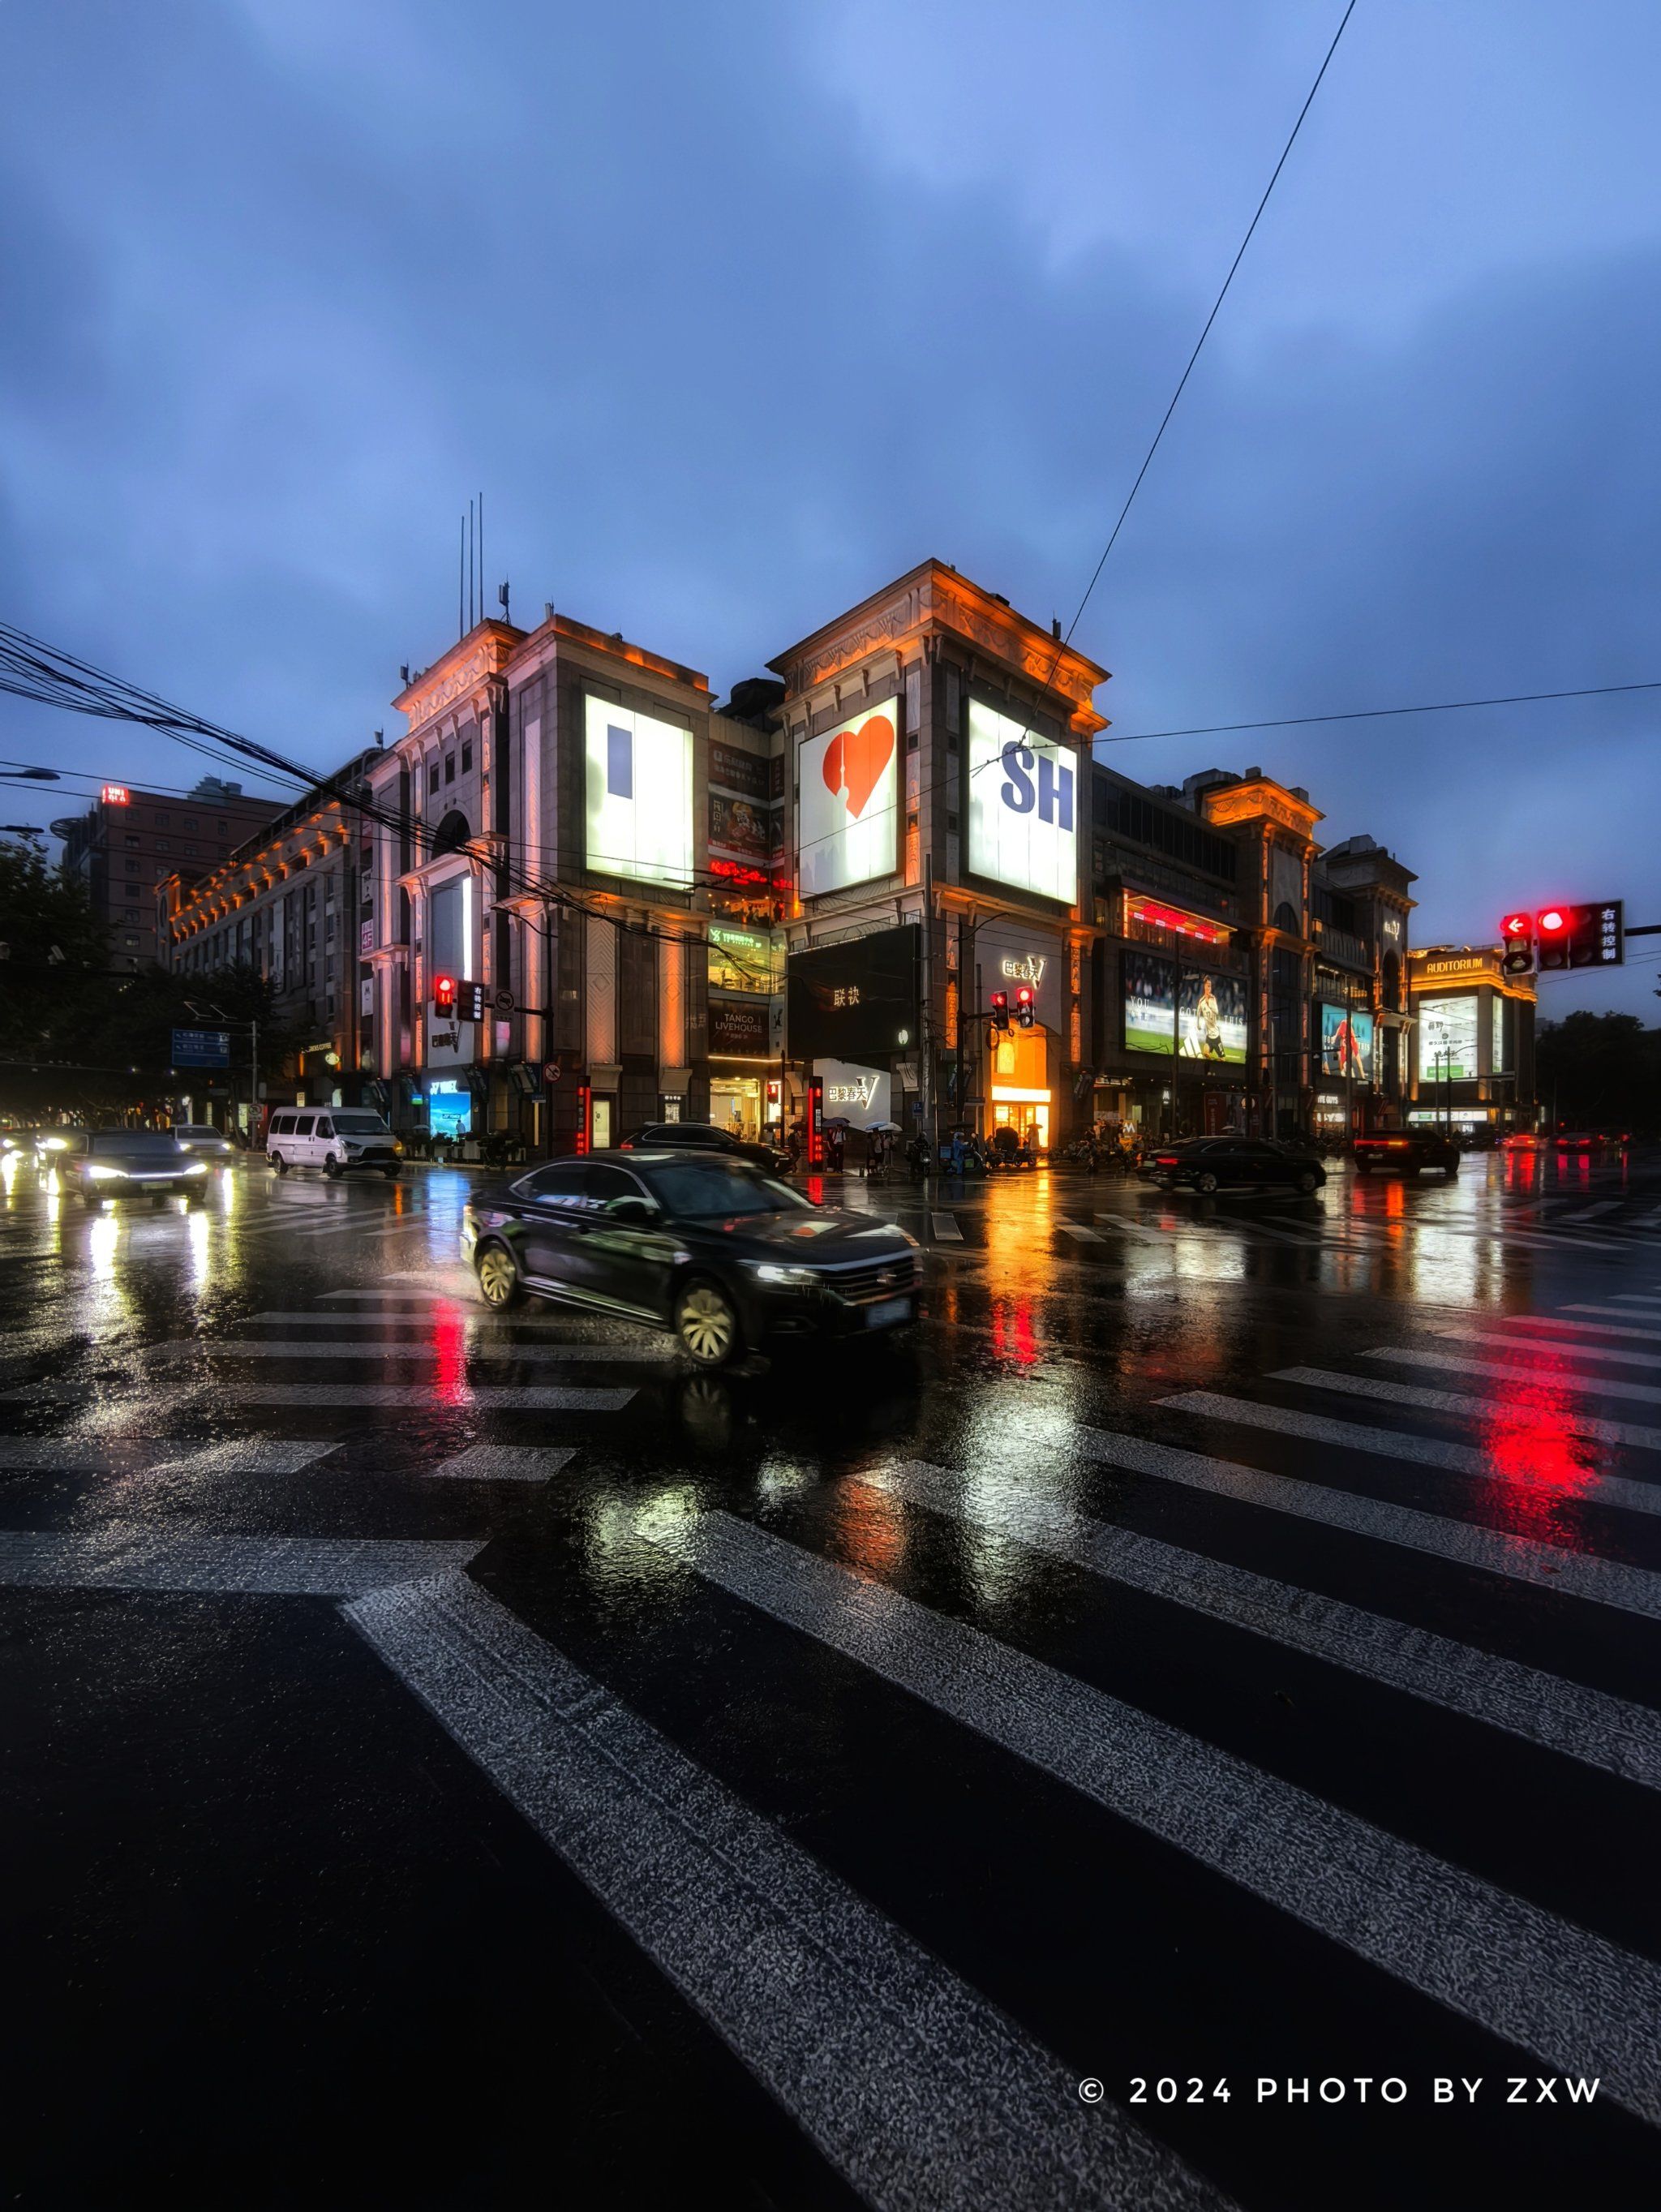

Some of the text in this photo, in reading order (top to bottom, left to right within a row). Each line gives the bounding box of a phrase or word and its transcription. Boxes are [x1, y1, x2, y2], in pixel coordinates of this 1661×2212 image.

[1000, 741, 1074, 833] SH
[1602, 908, 1616, 960] 右转控制
[1427, 958, 1483, 974] AUDITORIUM
[723, 1013, 755, 1024] TANGO
[1131, 995, 1150, 1010] YOU
[1223, 1014, 1244, 1027] THIS
[715, 1021, 763, 1034] LIVEHOUSE
[828, 1087, 867, 1101] 巴黎春天
